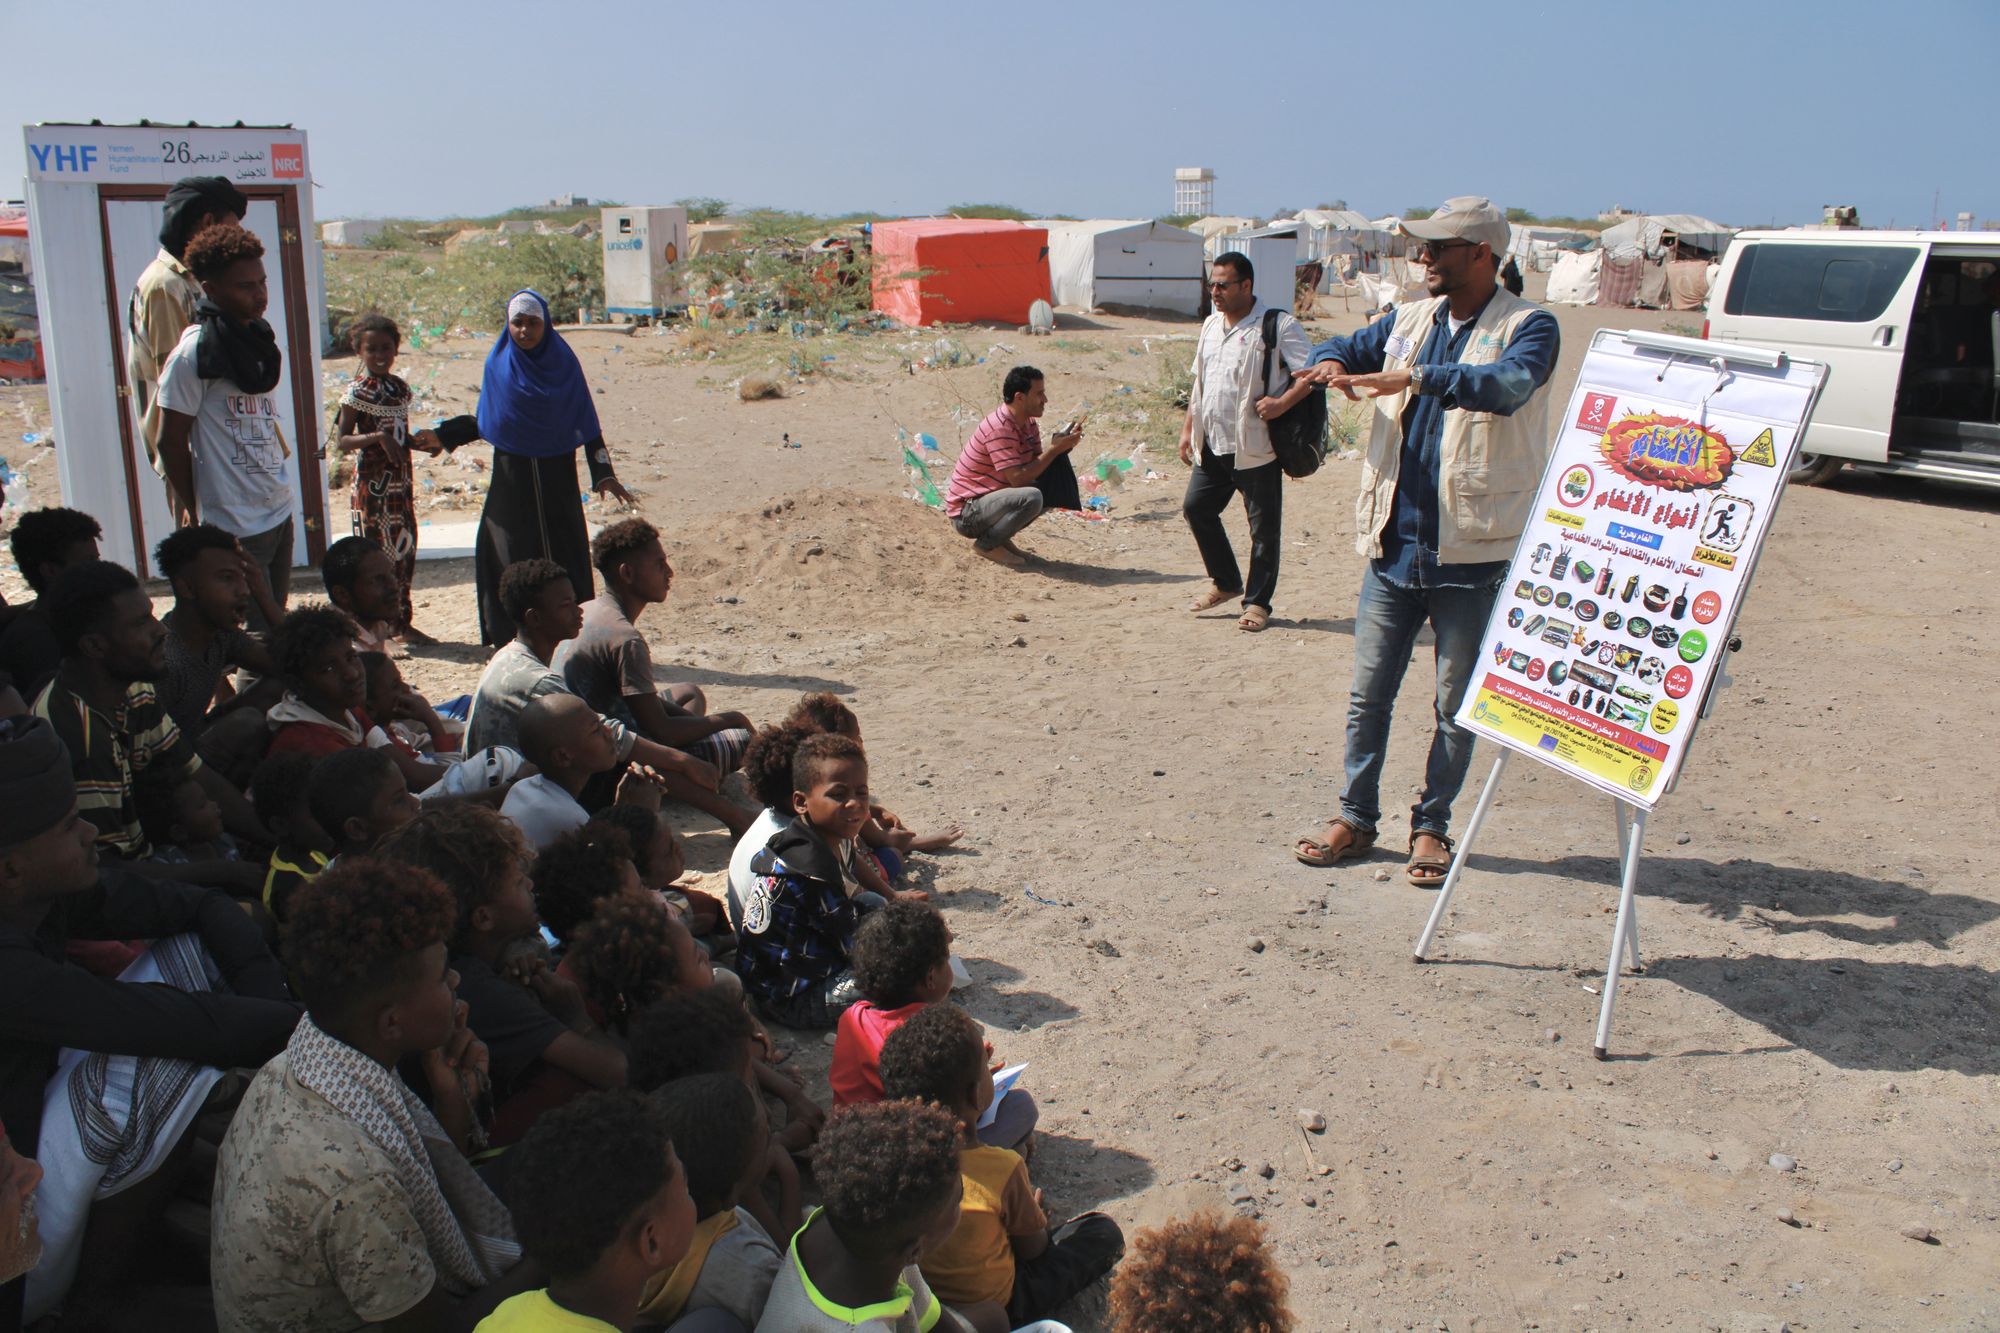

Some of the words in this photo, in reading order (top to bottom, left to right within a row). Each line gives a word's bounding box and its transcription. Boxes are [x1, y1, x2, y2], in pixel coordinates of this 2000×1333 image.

[107, 144, 134, 153] Yemen
[162, 141, 190, 164] 26
[30, 144, 97, 172] YHF
[108, 155, 160, 164] Humanitarian
[233, 152, 264, 163] المجلس
[109, 165, 129, 173] Fund
[275, 158, 300, 172] NRC
[607, 239, 632, 250] unicef
[1628, 426, 1704, 466] الألغام
[1747, 454, 1768, 464] DANGER
[1594, 488, 1652, 517] الألغام
[1653, 502, 1700, 530] أنواع
